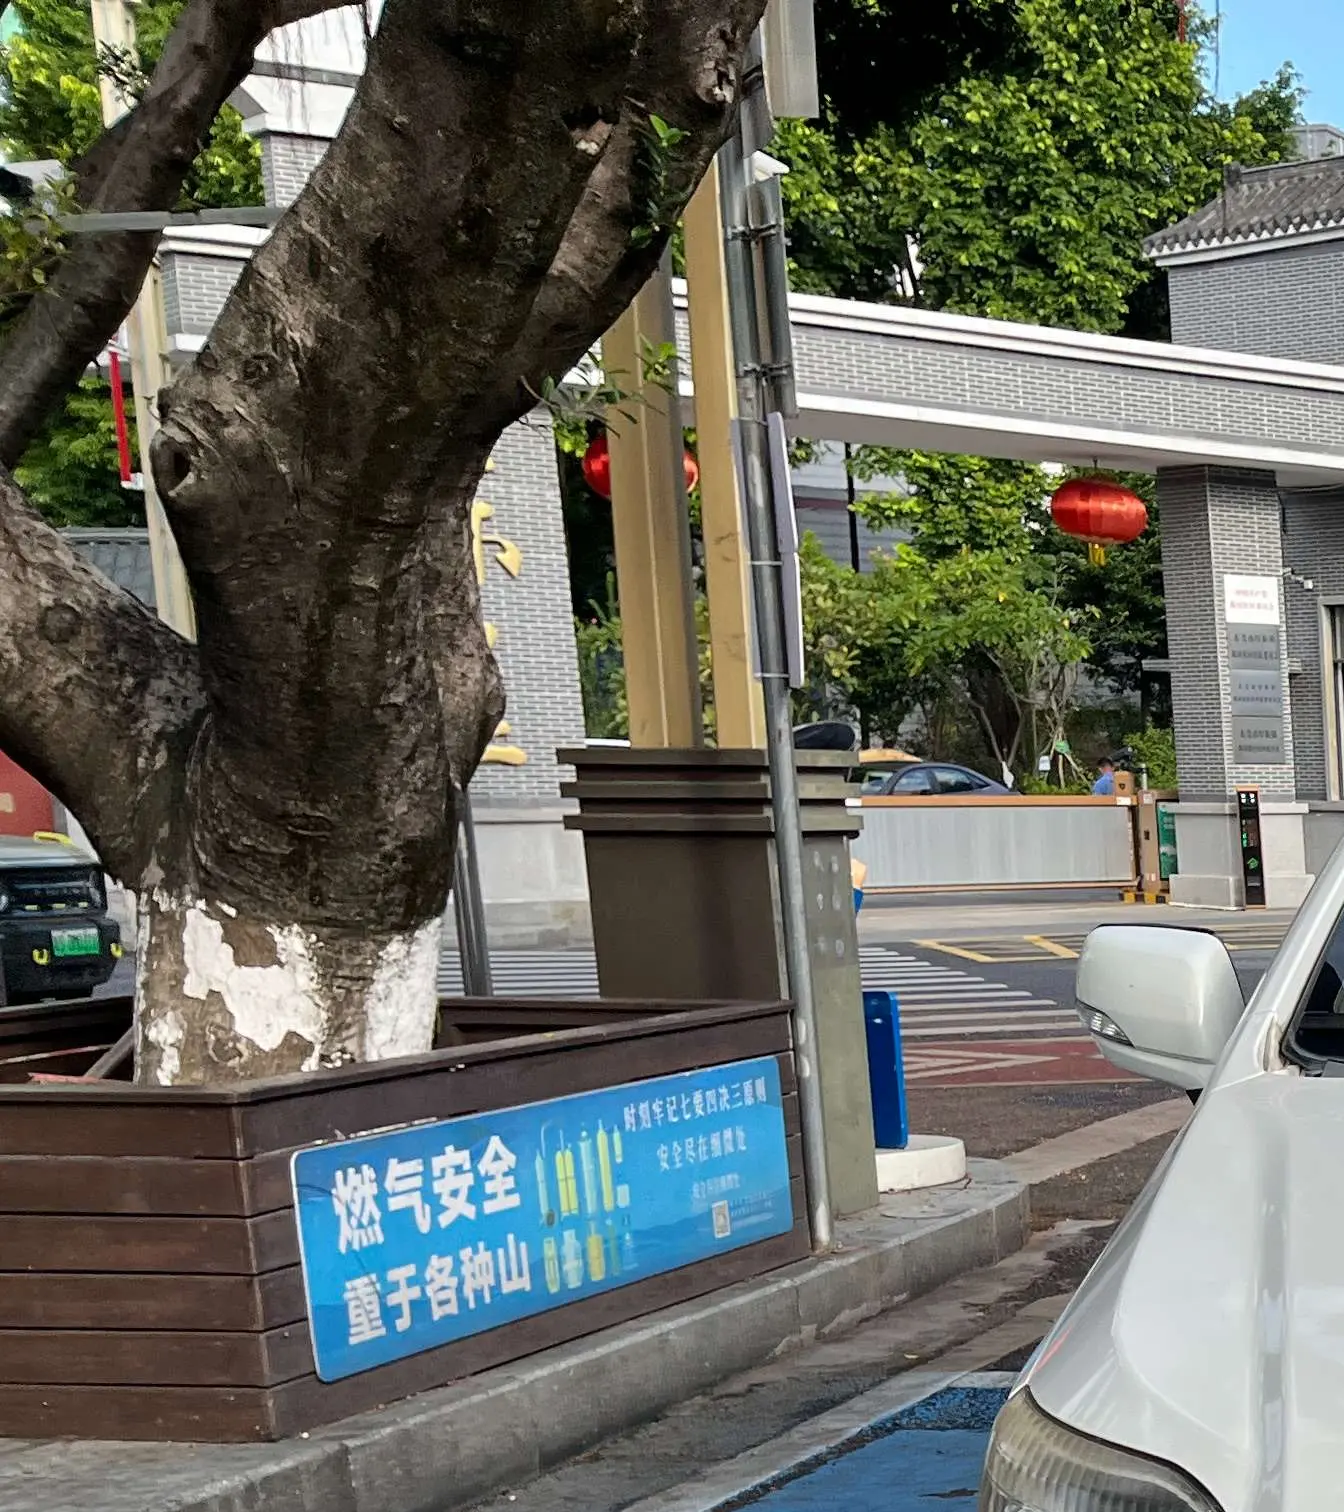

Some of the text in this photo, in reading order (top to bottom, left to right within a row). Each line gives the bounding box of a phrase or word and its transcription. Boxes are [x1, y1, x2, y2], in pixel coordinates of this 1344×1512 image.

[332, 1135, 521, 1254] 燃气安全
[343, 1233, 532, 1345] 重于各种山
